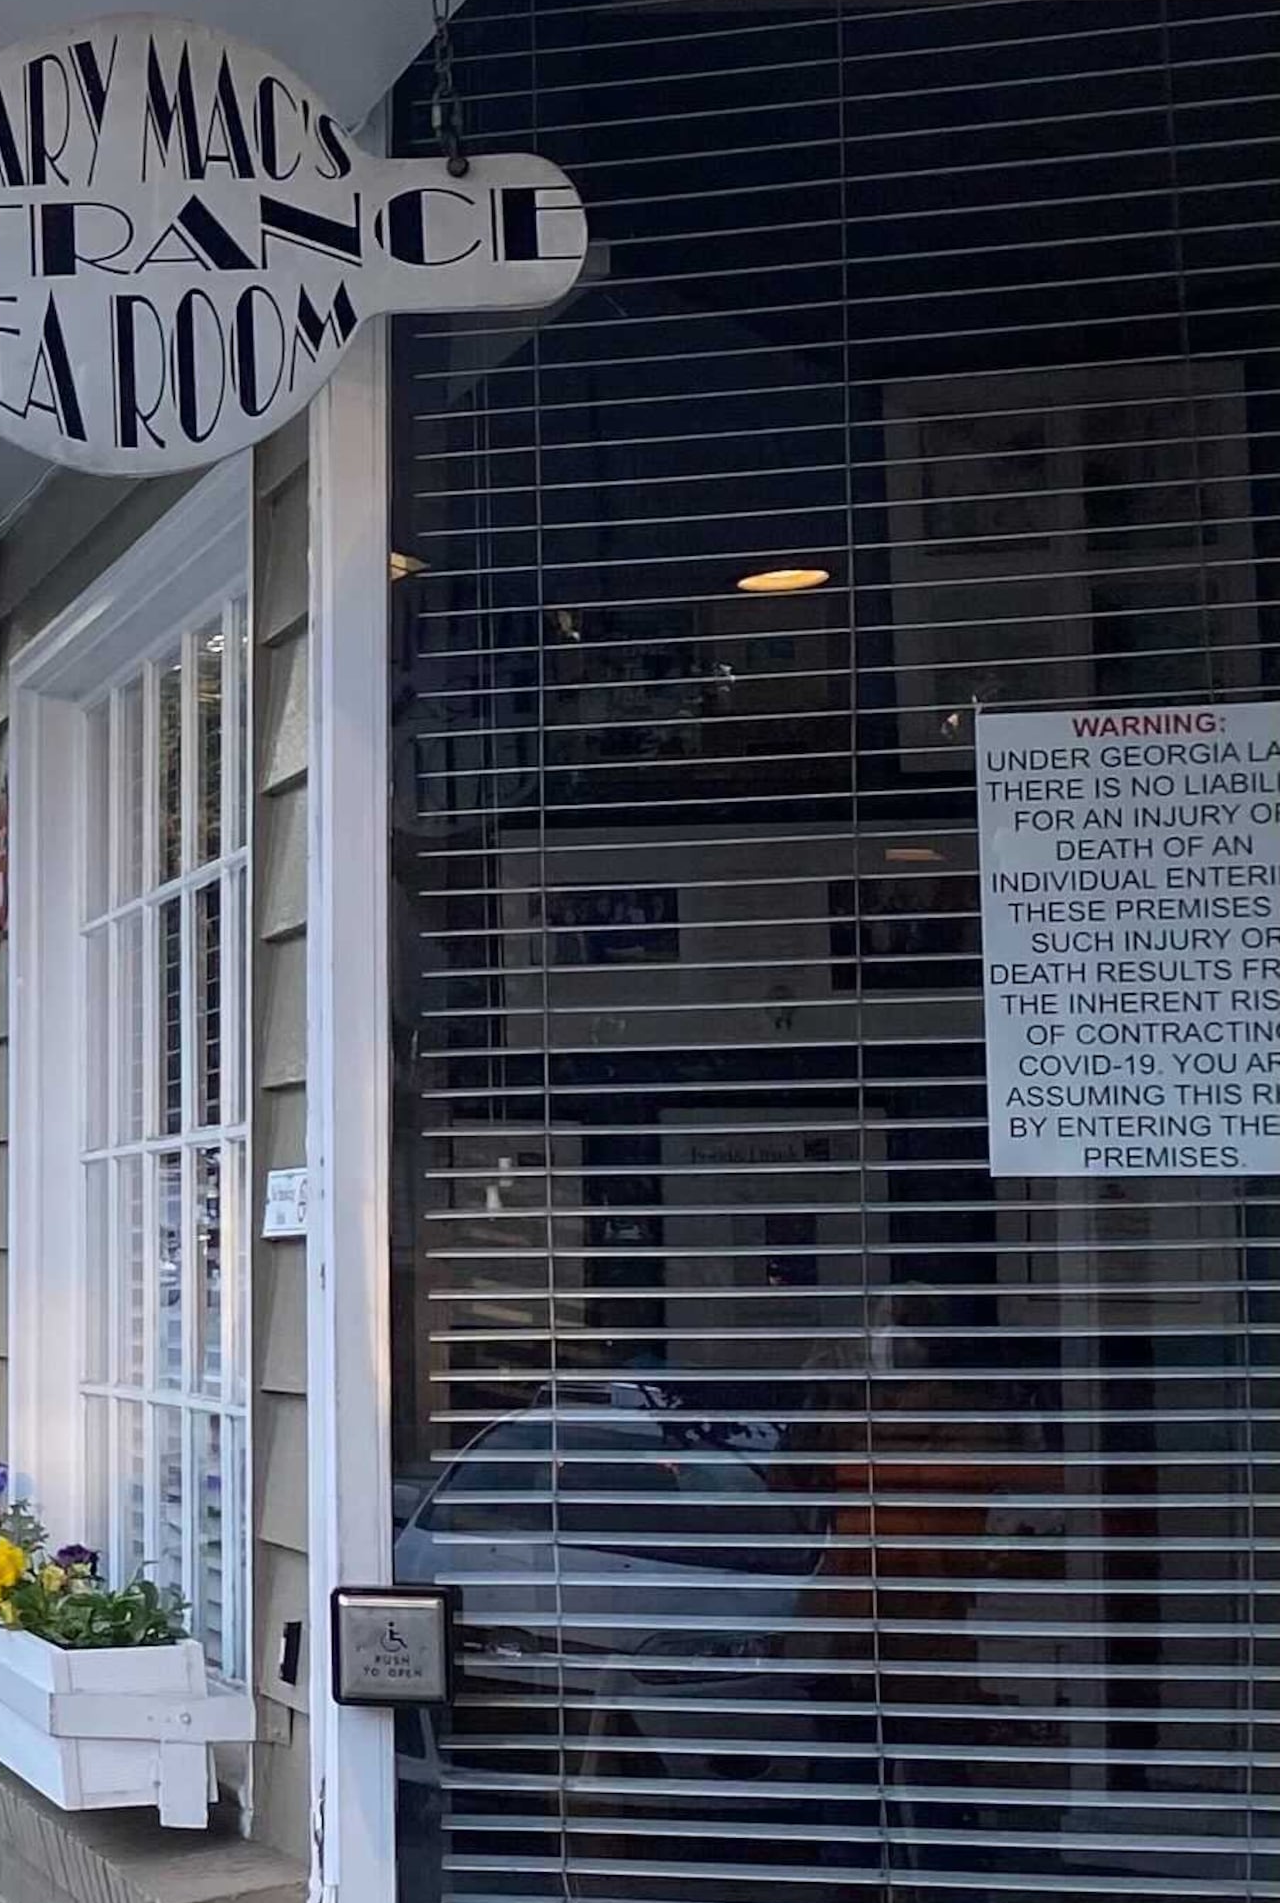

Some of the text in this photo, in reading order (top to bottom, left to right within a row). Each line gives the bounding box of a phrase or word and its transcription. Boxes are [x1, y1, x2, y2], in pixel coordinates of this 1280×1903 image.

[140, 33, 353, 183] MAC'S
[110, 281, 358, 449] ROOM
[1072, 713, 1226, 738] WARNING:
[987, 748, 1091, 772] UNDER
[1100, 742, 1240, 768] GEORGIA
[985, 779, 1085, 803] THERE
[1095, 777, 1121, 799] IS
[1132, 775, 1175, 797] NO
[1014, 809, 1075, 833] FOR
[1083, 808, 1123, 830] AN
[1134, 804, 1240, 828] INJURY
[1056, 835, 1253, 861] DEATH OF AN
[992, 866, 1280, 894] INDIVIDUAL ENTERI
[1008, 897, 1272, 924] THESE PREMISES
[1031, 931, 1113, 954] SUCH
[1125, 929, 1231, 952] INJURY
[990, 959, 1280, 985] DEATH RESULTS FR
[1001, 994, 1058, 1015] THE
[1070, 991, 1222, 1014] INHERENT
[1026, 1021, 1280, 1045] OF CONTRACTIN
[1019, 1054, 1164, 1076] COVID-19.
[1172, 1053, 1237, 1074] YOU
[1006, 1085, 1165, 1107] ASSUMING
[1175, 1083, 1242, 1105] THIS
[1010, 1116, 1047, 1138] BY
[1058, 1115, 1211, 1137] ENTERING
[1084, 1147, 1246, 1168] PREMISES.
[363, 1666, 424, 1679] TO OPEN
[375, 1654, 410, 1666] PUSH
